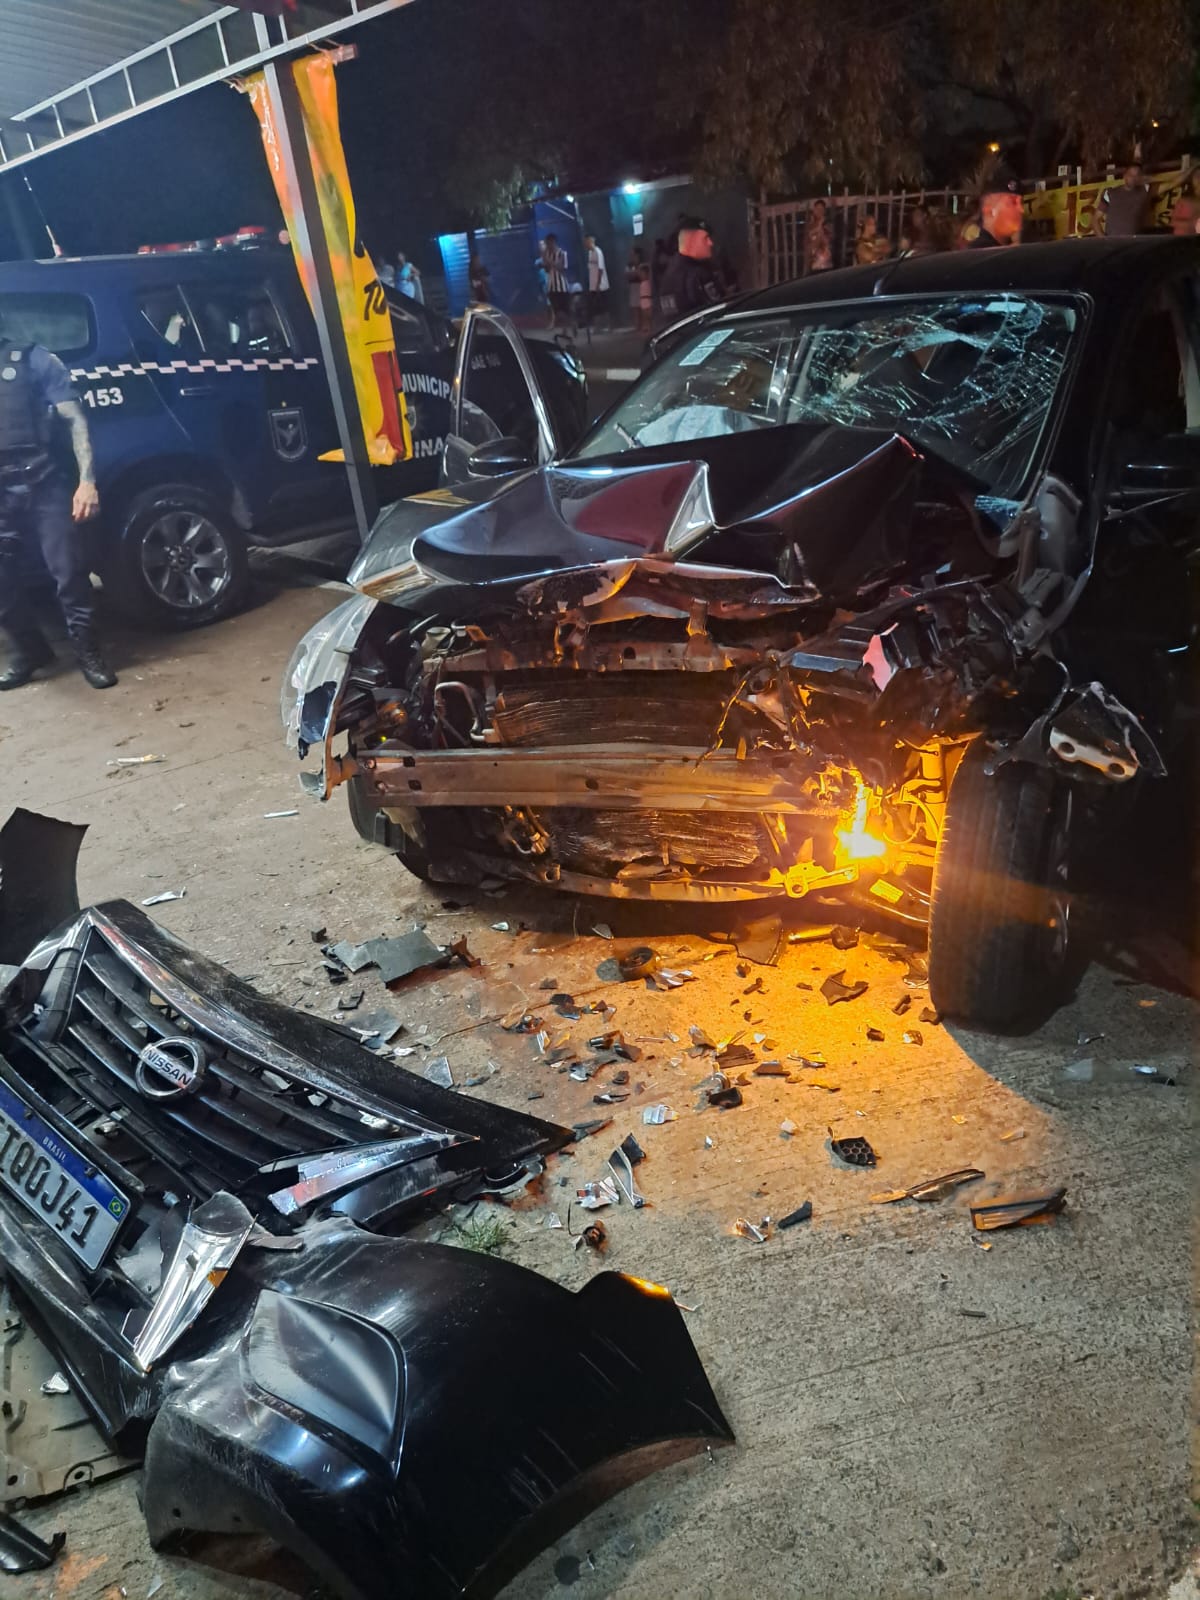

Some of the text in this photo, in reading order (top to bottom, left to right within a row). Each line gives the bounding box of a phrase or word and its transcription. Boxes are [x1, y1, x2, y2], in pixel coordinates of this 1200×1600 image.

[84, 387, 124, 408] 153
[414, 437, 444, 458] INA
[144, 1049, 193, 1086] NISSAN
[42, 1135, 66, 1163] BRASIL
[0, 1115, 100, 1249] TQ0J41
